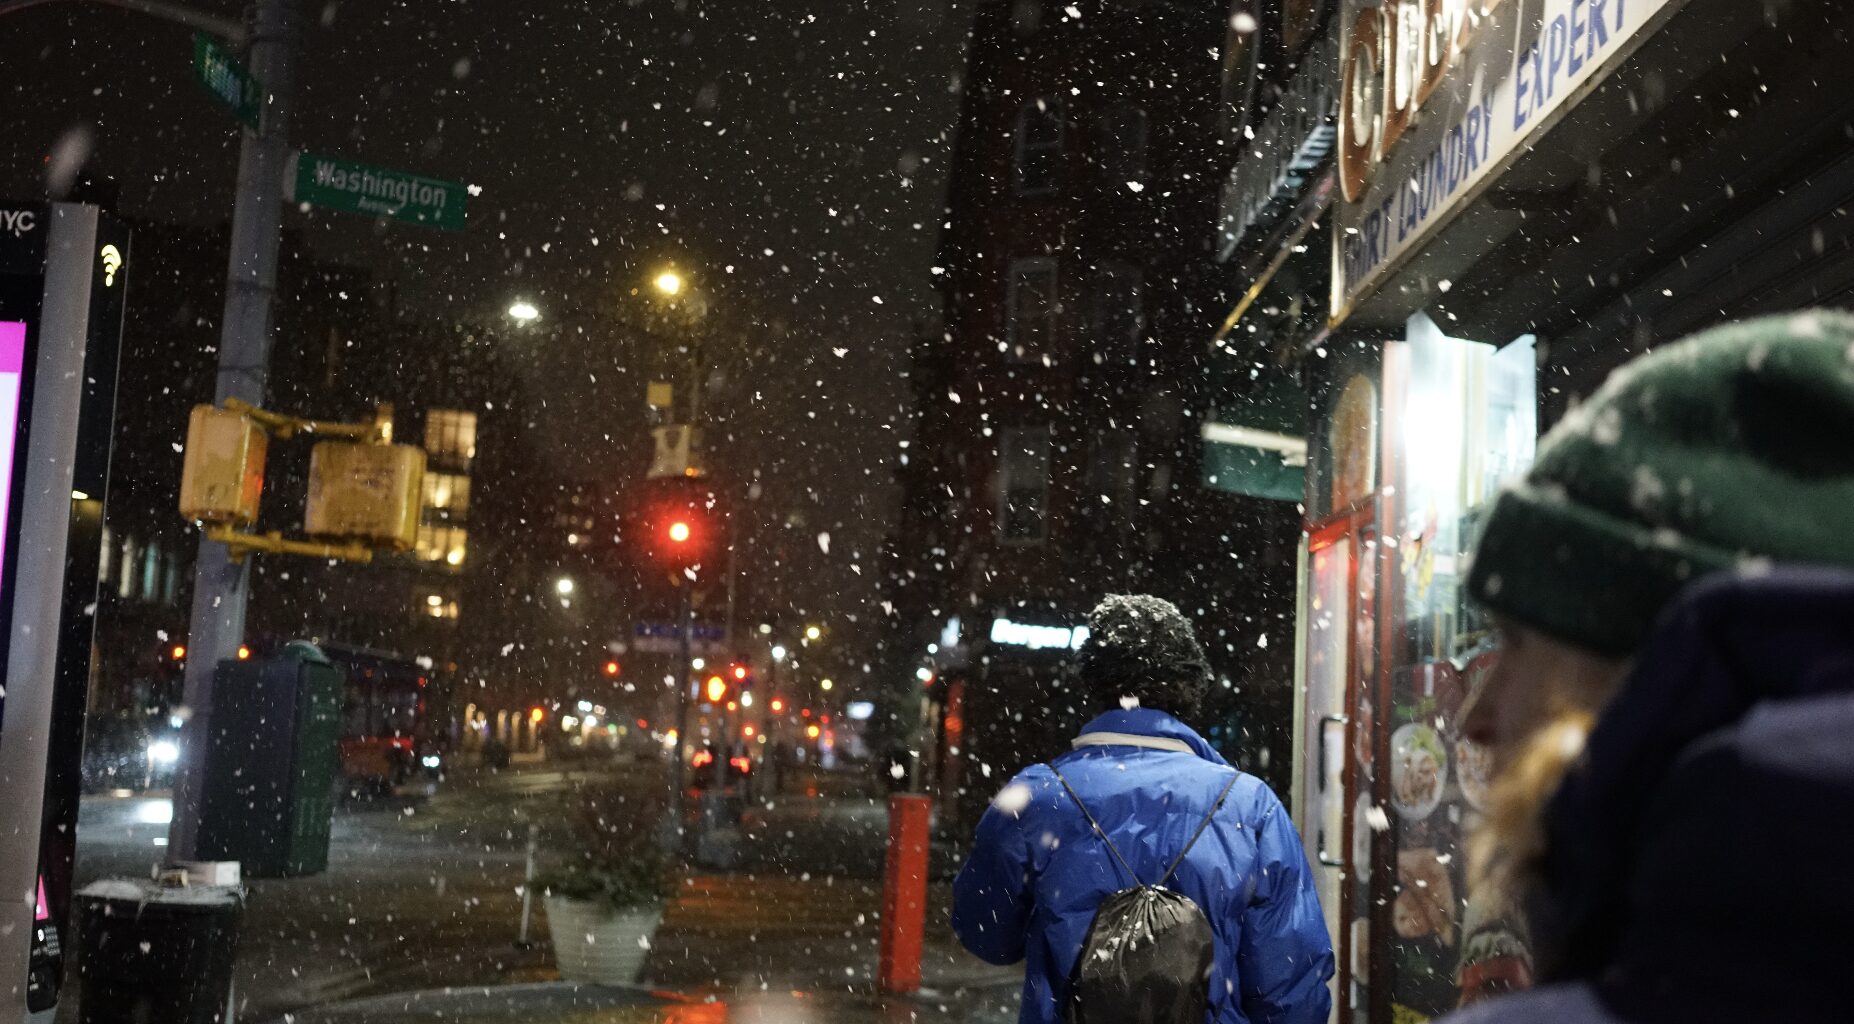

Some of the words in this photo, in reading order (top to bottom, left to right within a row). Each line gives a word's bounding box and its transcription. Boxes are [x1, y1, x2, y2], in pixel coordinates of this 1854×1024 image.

[314, 159, 447, 208] Washington
[1397, 86, 1496, 242] LAUNDRY
[0, 210, 35, 231] YC
